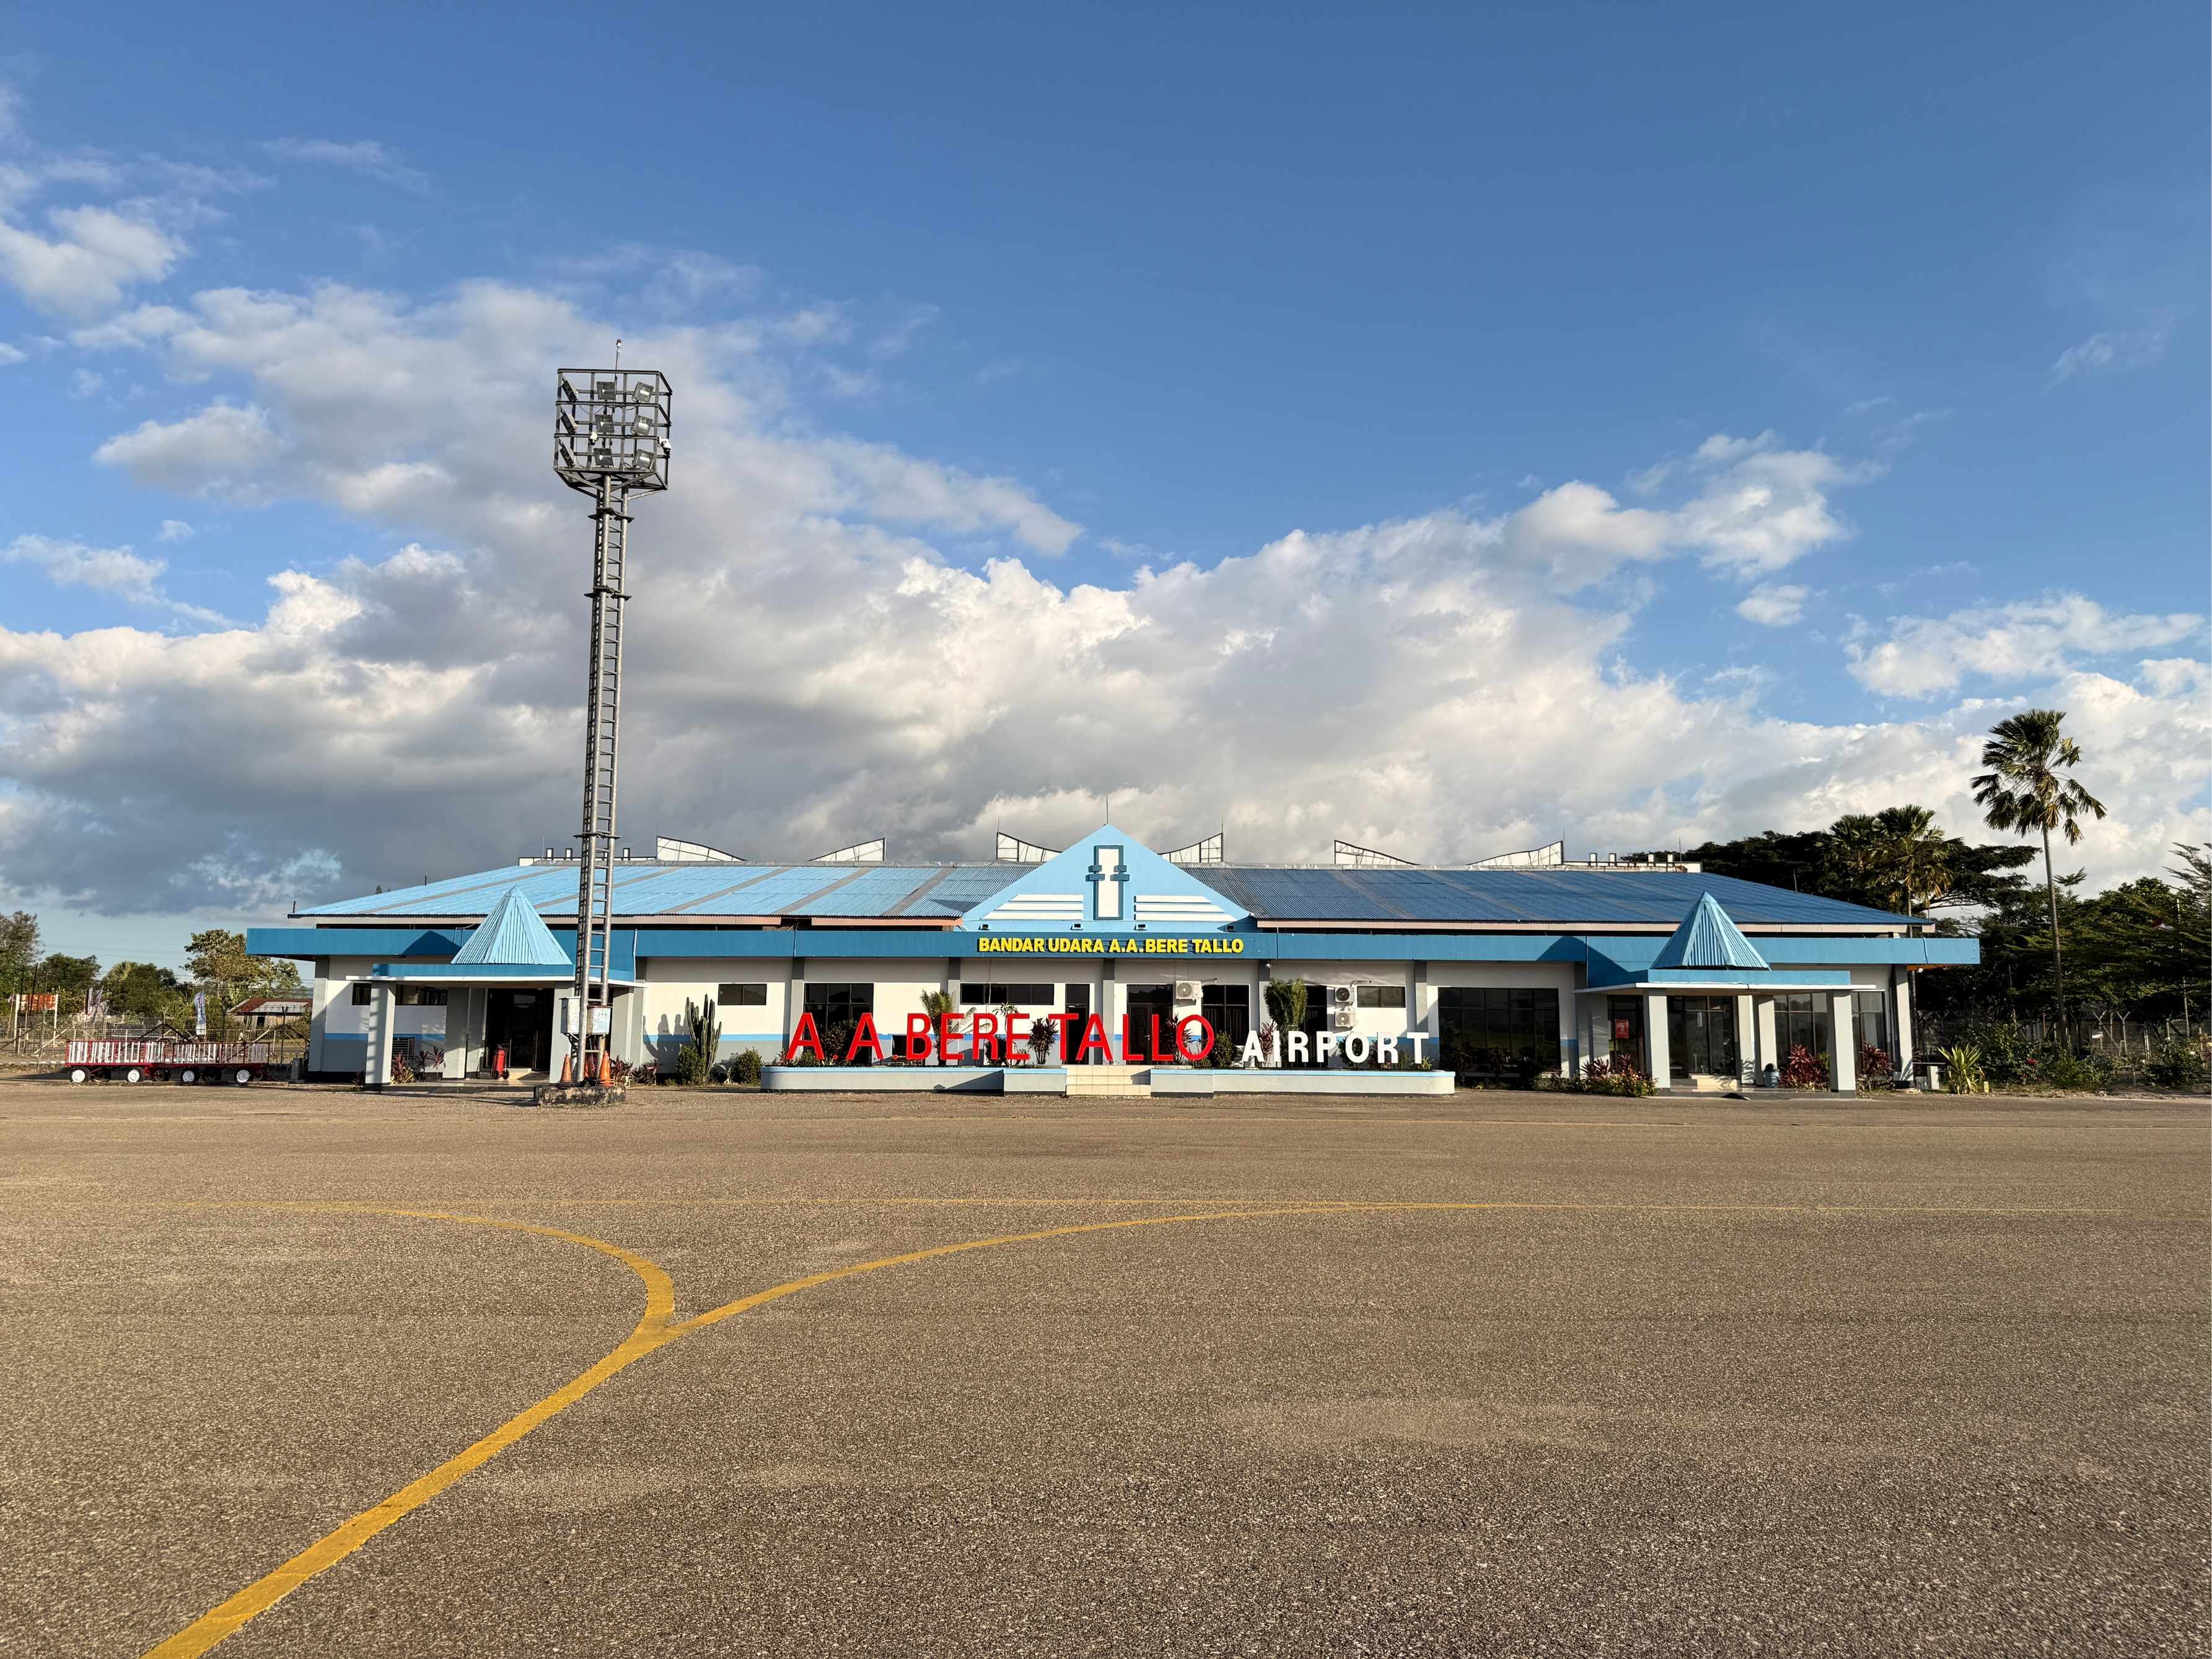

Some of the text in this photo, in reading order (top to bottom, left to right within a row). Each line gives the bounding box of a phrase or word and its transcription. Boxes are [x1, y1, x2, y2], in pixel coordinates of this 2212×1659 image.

[979, 938, 1045, 953] BANDAR
[1048, 938, 1105, 953] UDARA
[1192, 940, 1244, 953] TALLO
[1048, 1013, 1215, 1061] TALLO
[1242, 1031, 1429, 1064] AIRPORT
